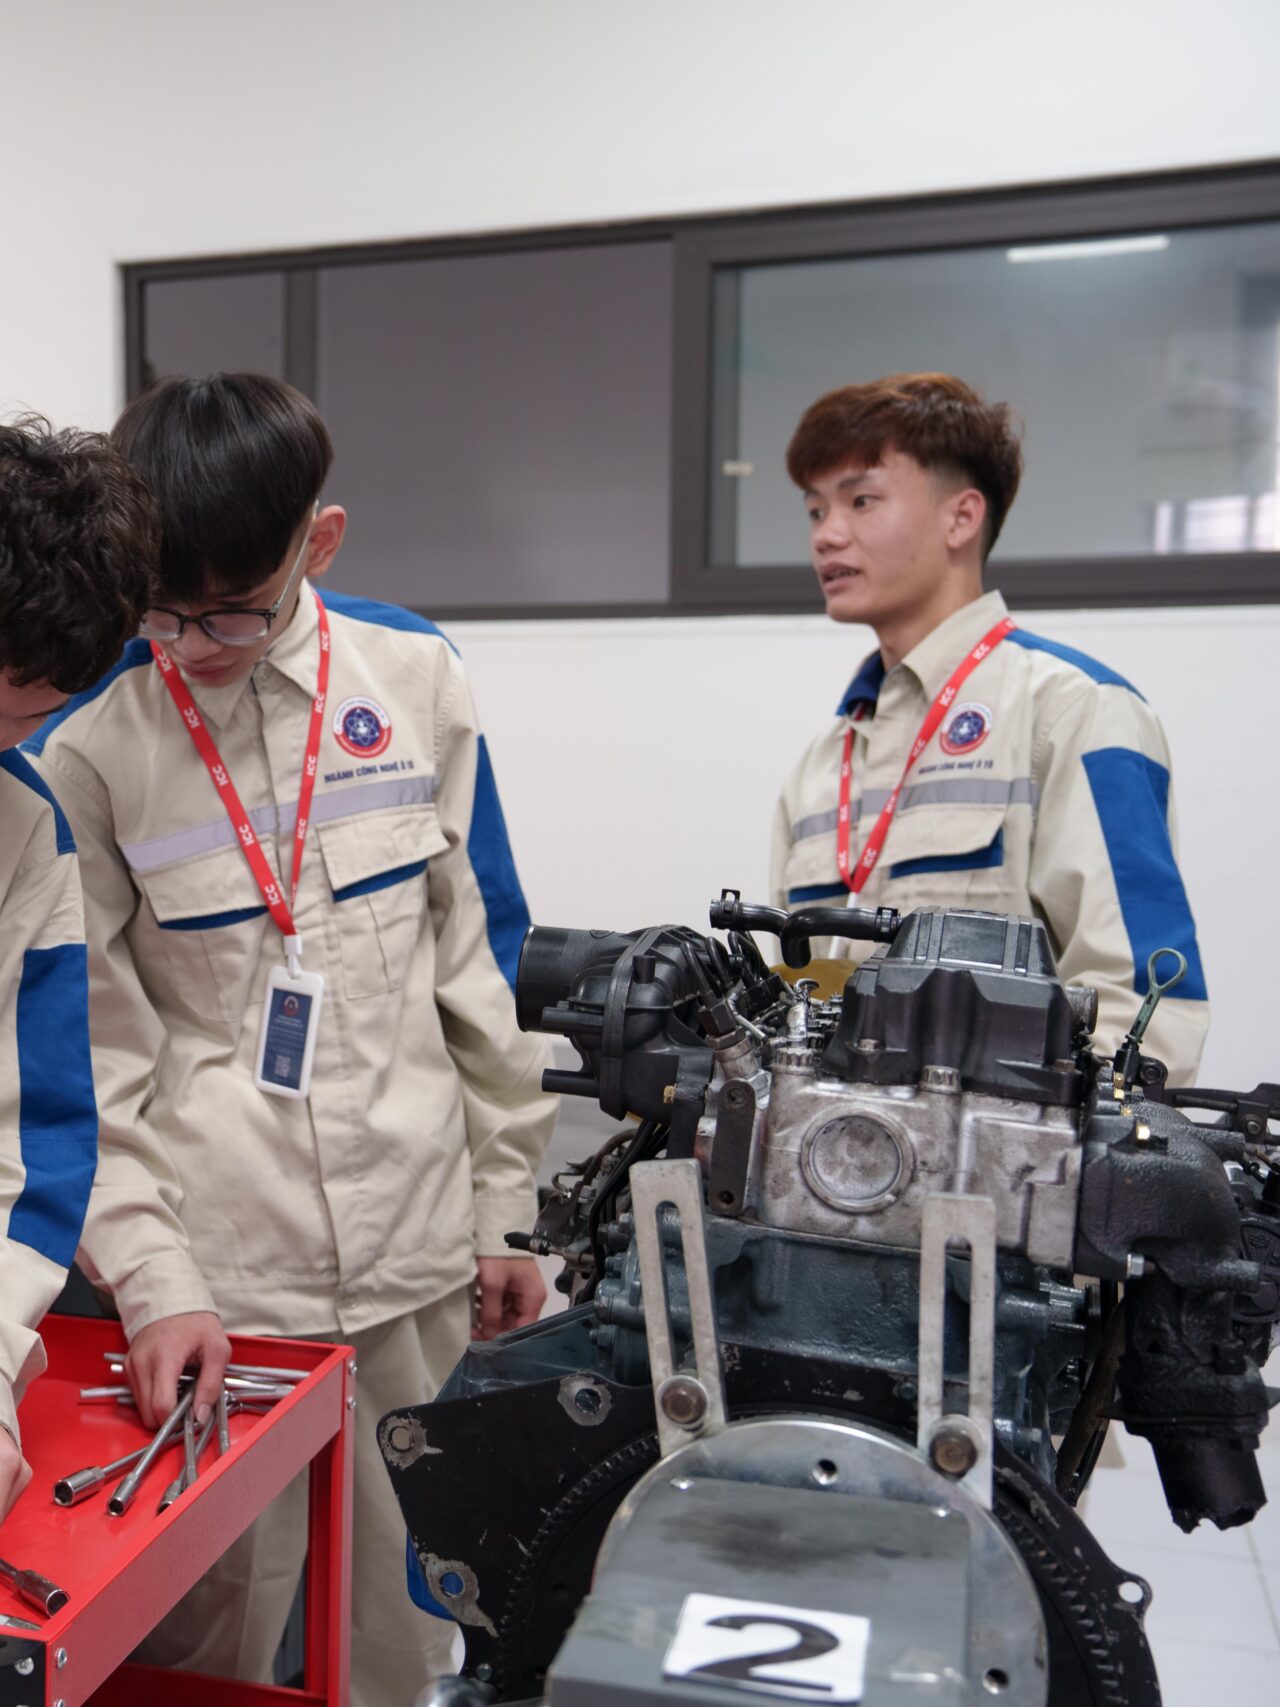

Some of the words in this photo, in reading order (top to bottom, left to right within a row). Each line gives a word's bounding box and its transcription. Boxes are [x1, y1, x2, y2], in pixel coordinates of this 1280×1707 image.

[314, 692, 325, 714] ICC
[184, 707, 200, 729] ICC
[212, 764, 229, 786] ICC
[307, 754, 317, 776] ICC
[239, 824, 255, 846] ICC
[264, 883, 281, 906] ICC
[687, 1614, 840, 1692] 2
